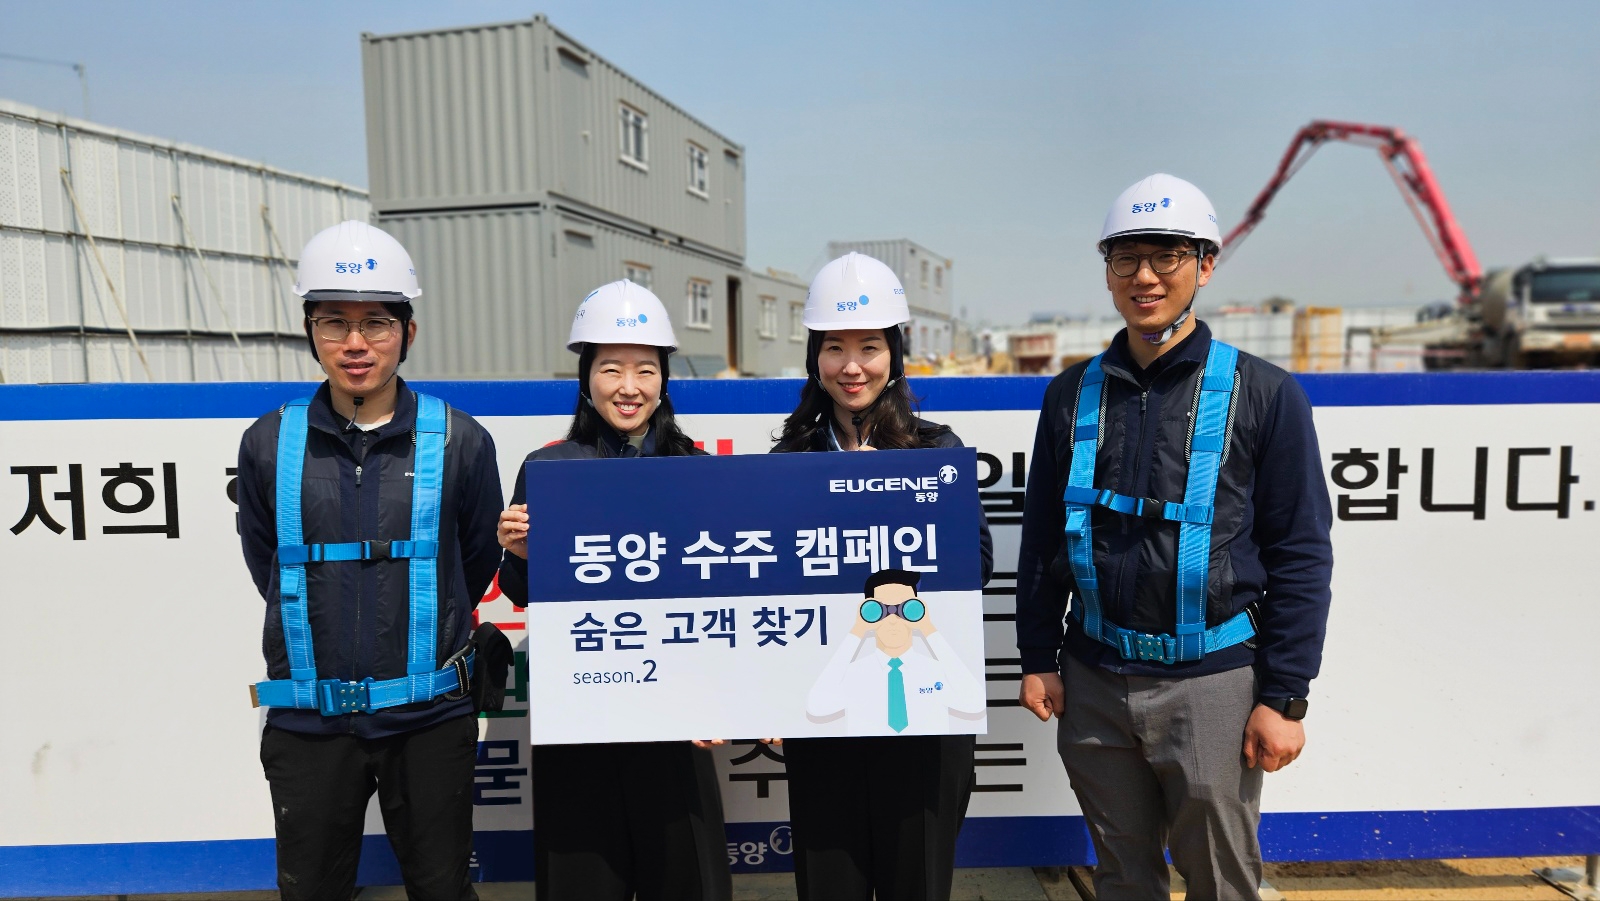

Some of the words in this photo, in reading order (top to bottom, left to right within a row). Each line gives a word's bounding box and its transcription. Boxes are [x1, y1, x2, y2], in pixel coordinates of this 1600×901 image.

[1132, 202, 1157, 213] 동양
[335, 262, 363, 274] 동양
[836, 301, 858, 312] 동양
[616, 317, 637, 328] 동양
[829, 476, 939, 493] EUGENE
[10, 462, 180, 541] 저희
[915, 491, 939, 503] 동양
[569, 531, 667, 584] 동양
[681, 530, 778, 580] 수주
[795, 523, 939, 577] 캠페인
[570, 611, 648, 652] 숨은
[661, 607, 736, 648] 고객
[751, 605, 828, 648] 찾기
[573, 659, 658, 685] season.2
